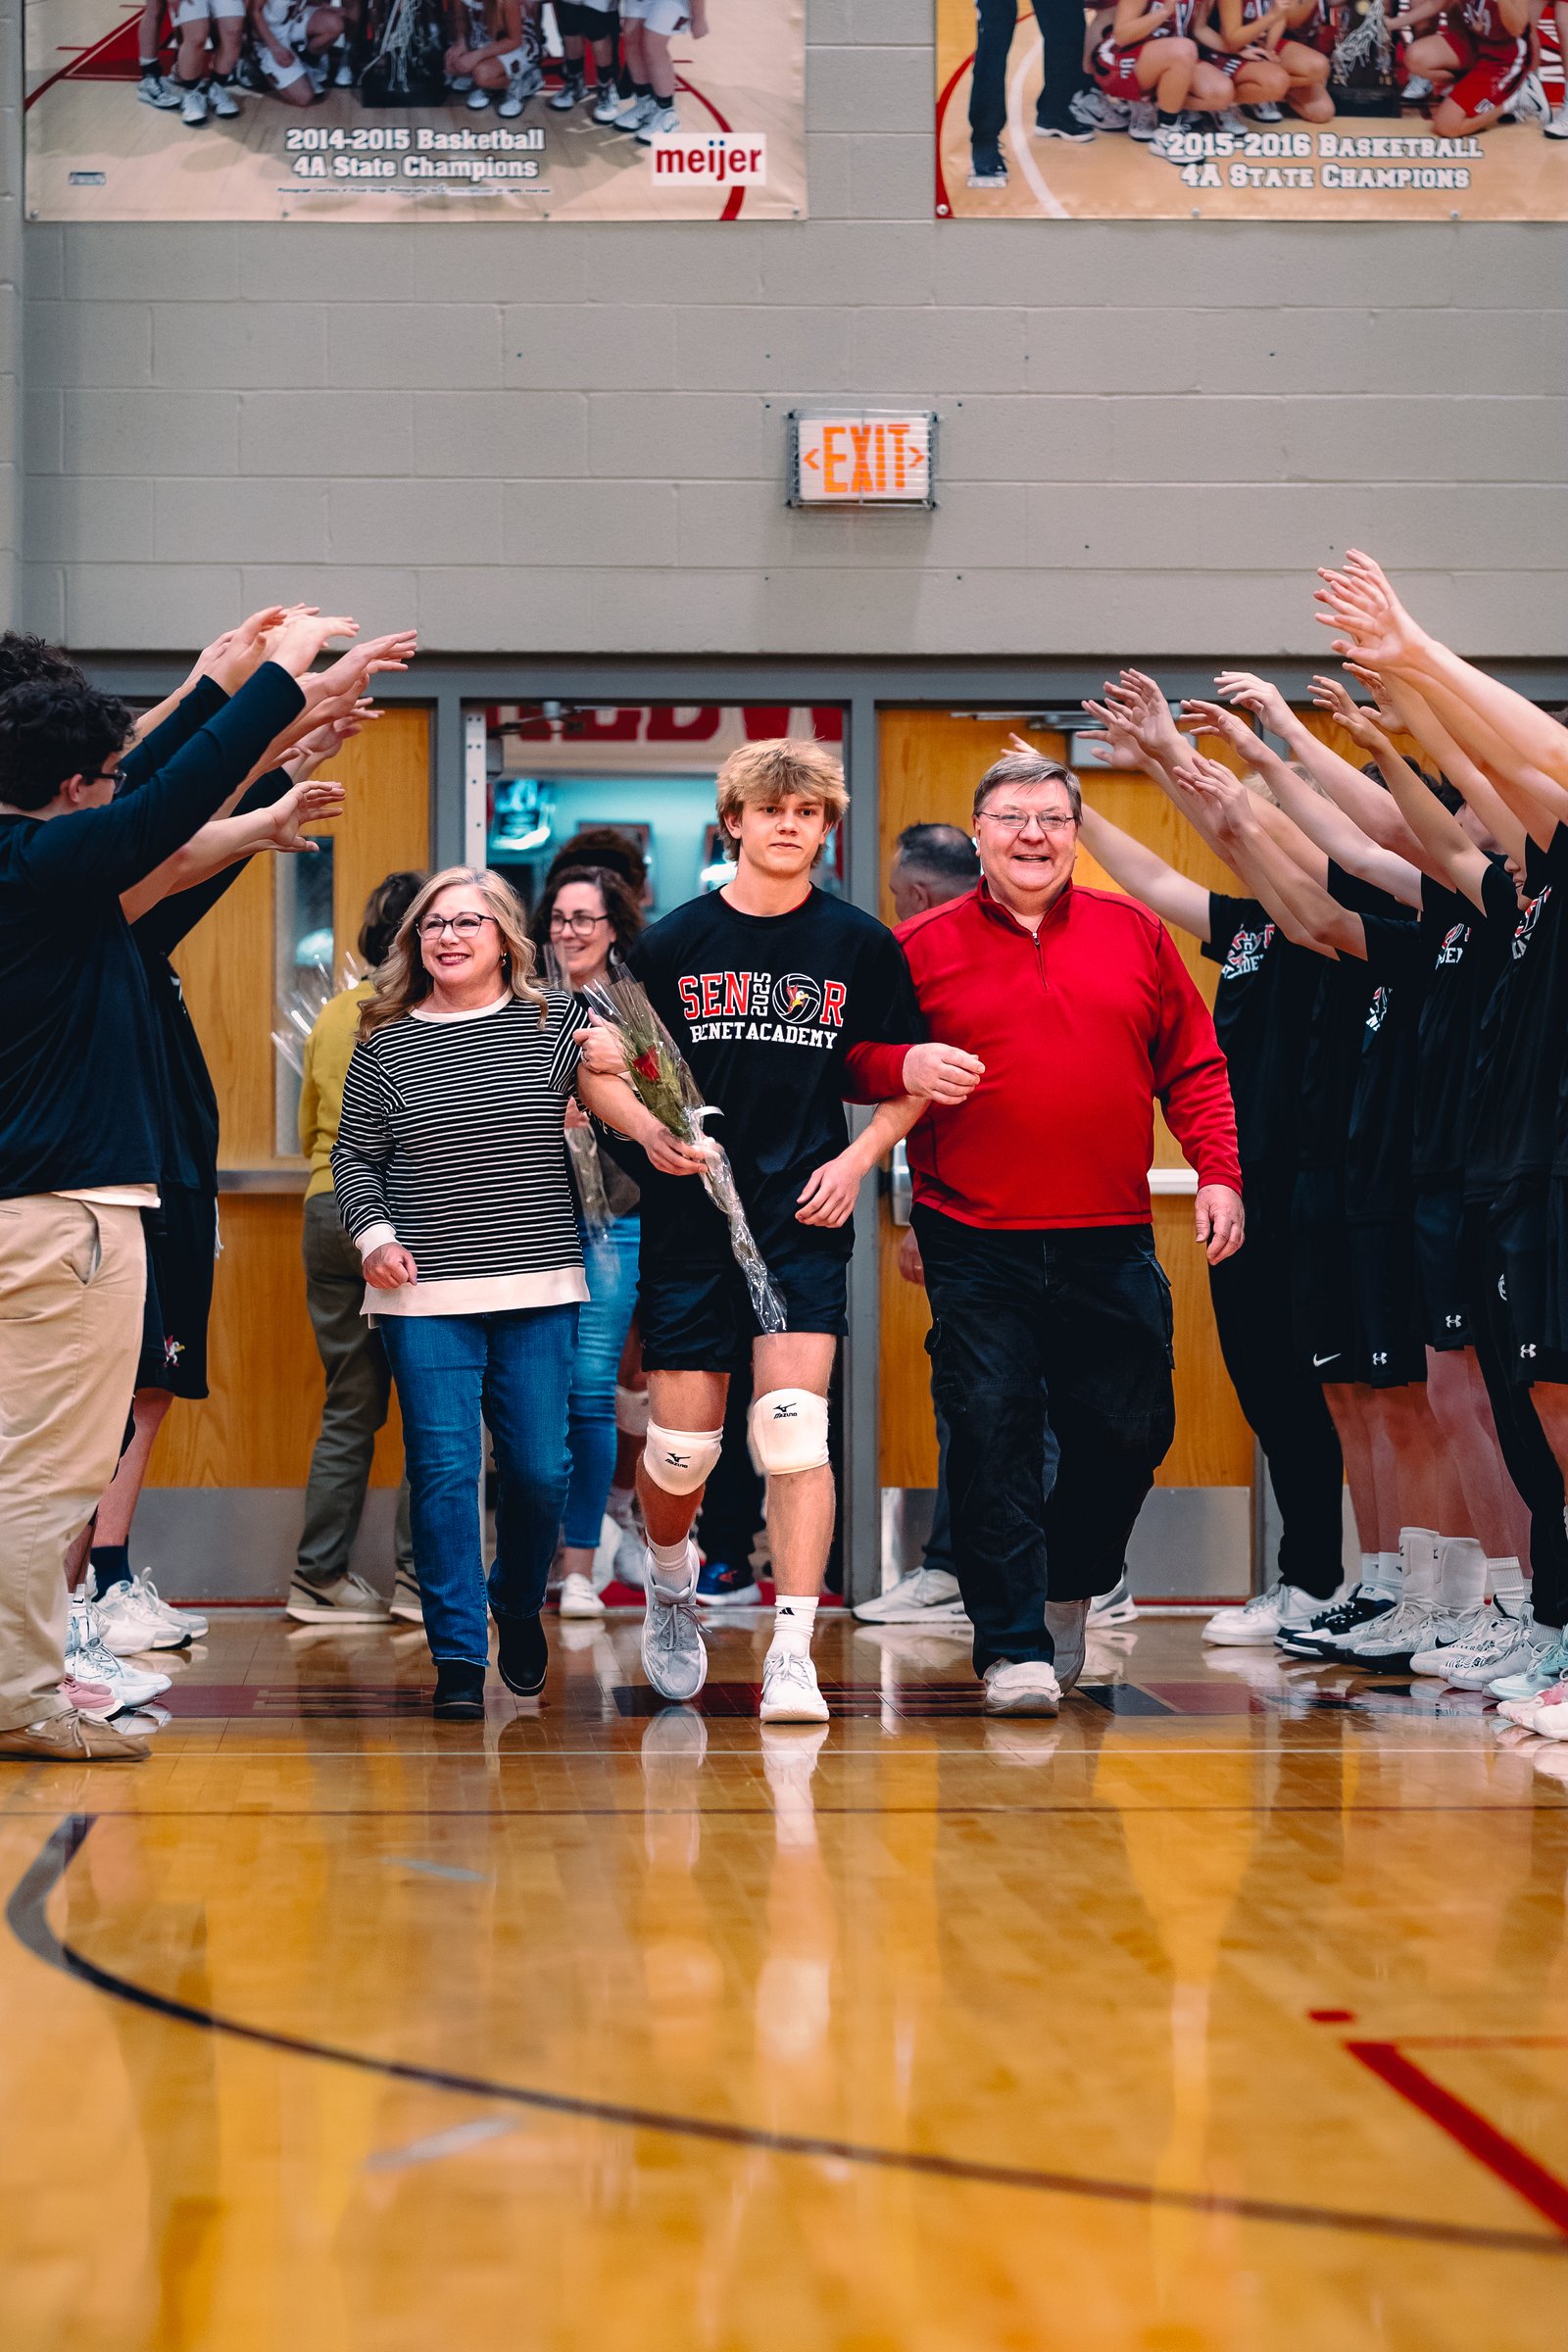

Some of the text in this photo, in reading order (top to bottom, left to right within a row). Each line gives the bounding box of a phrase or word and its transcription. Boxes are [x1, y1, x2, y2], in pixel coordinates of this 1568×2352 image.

[285, 127, 546, 151] 2014-2015 Basketball
[1166, 131, 1485, 160] 2015-2016 BASKETBALL
[292, 154, 539, 182] 4A State Champions
[656, 139, 762, 181] meijer
[1180, 163, 1470, 189] 4A STATE CHAMPIONS
[822, 423, 910, 493] EXIT
[751, 971, 772, 1017] 2025
